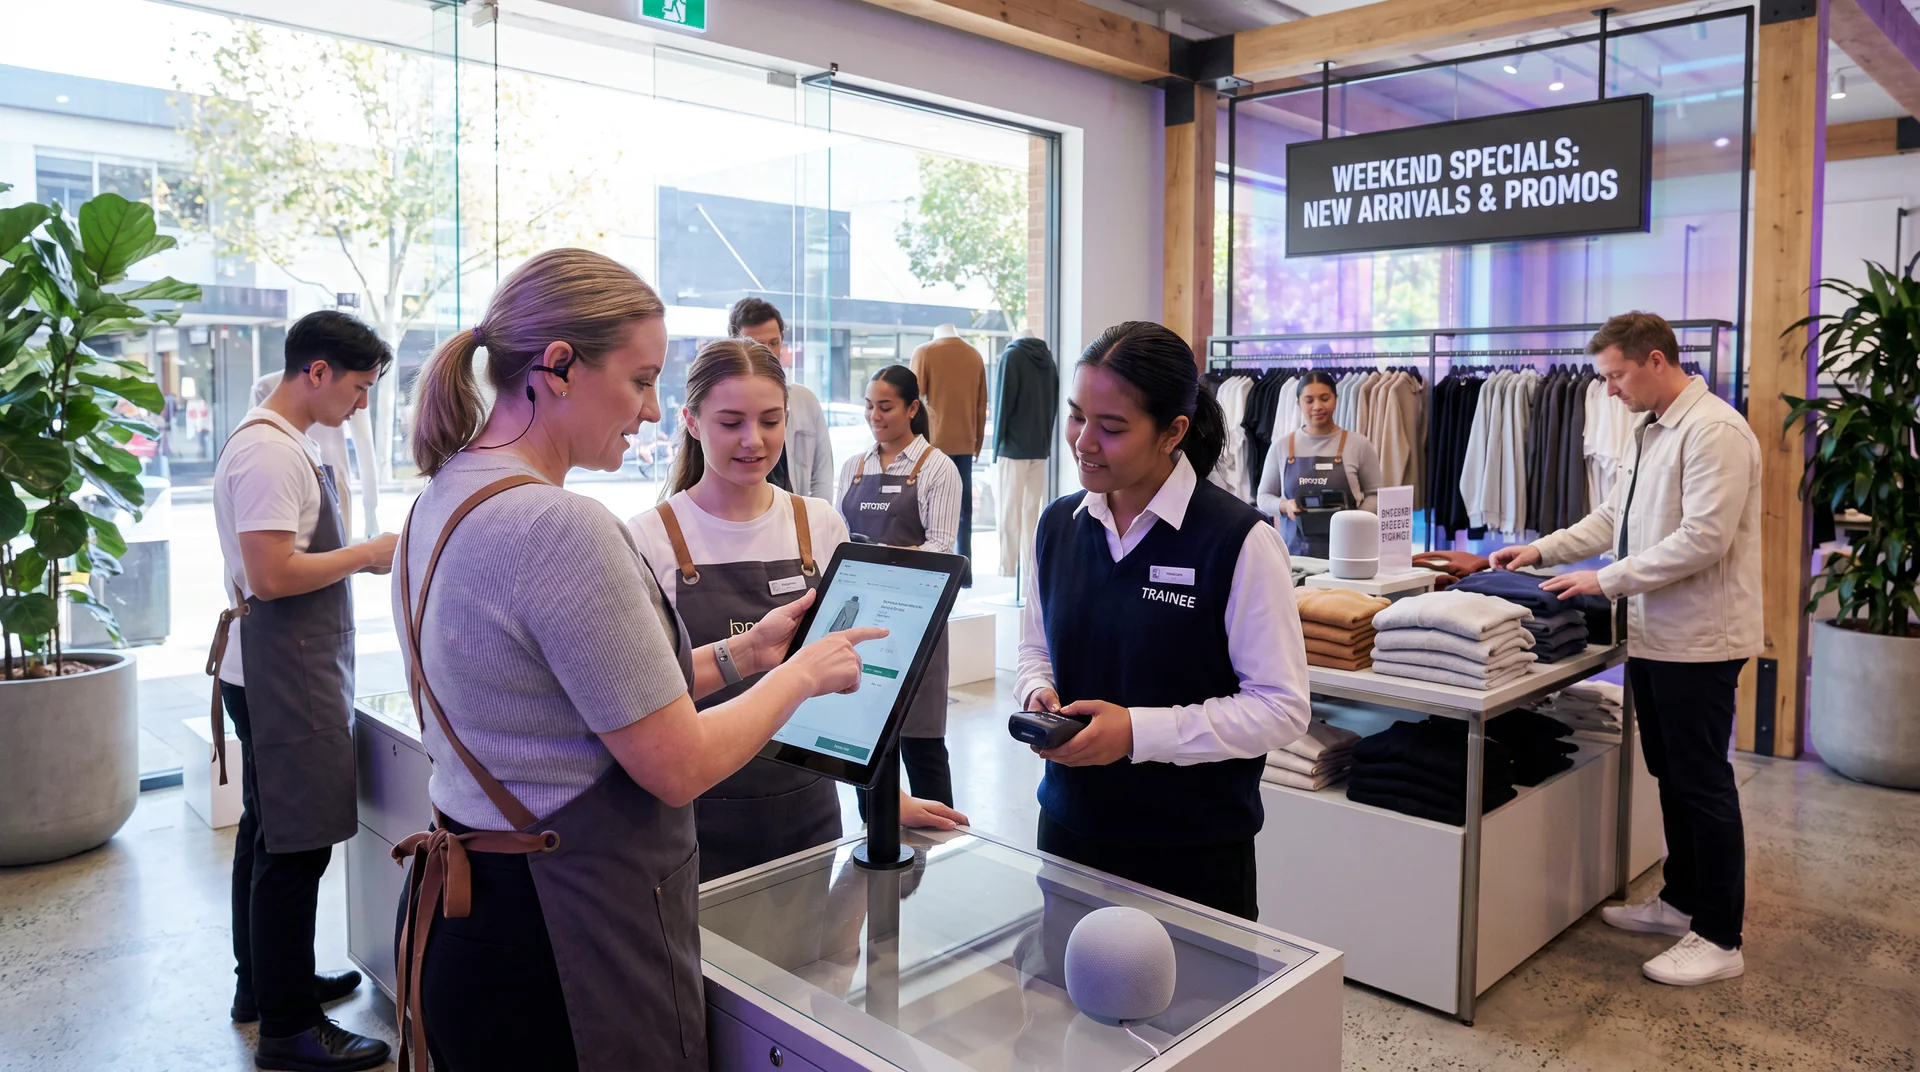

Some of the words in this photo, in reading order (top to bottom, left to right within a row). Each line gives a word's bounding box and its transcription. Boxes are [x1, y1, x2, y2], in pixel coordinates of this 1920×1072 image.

[1332, 153, 1442, 193] WEEKEND
[1449, 136, 1580, 180] SPECIALS:
[1303, 197, 1353, 229] NEW
[1357, 184, 1471, 224] ARRIVALS
[1477, 182, 1497, 212] &
[1504, 168, 1619, 210] PROMOS
[1142, 587, 1196, 609] TRAINEE
